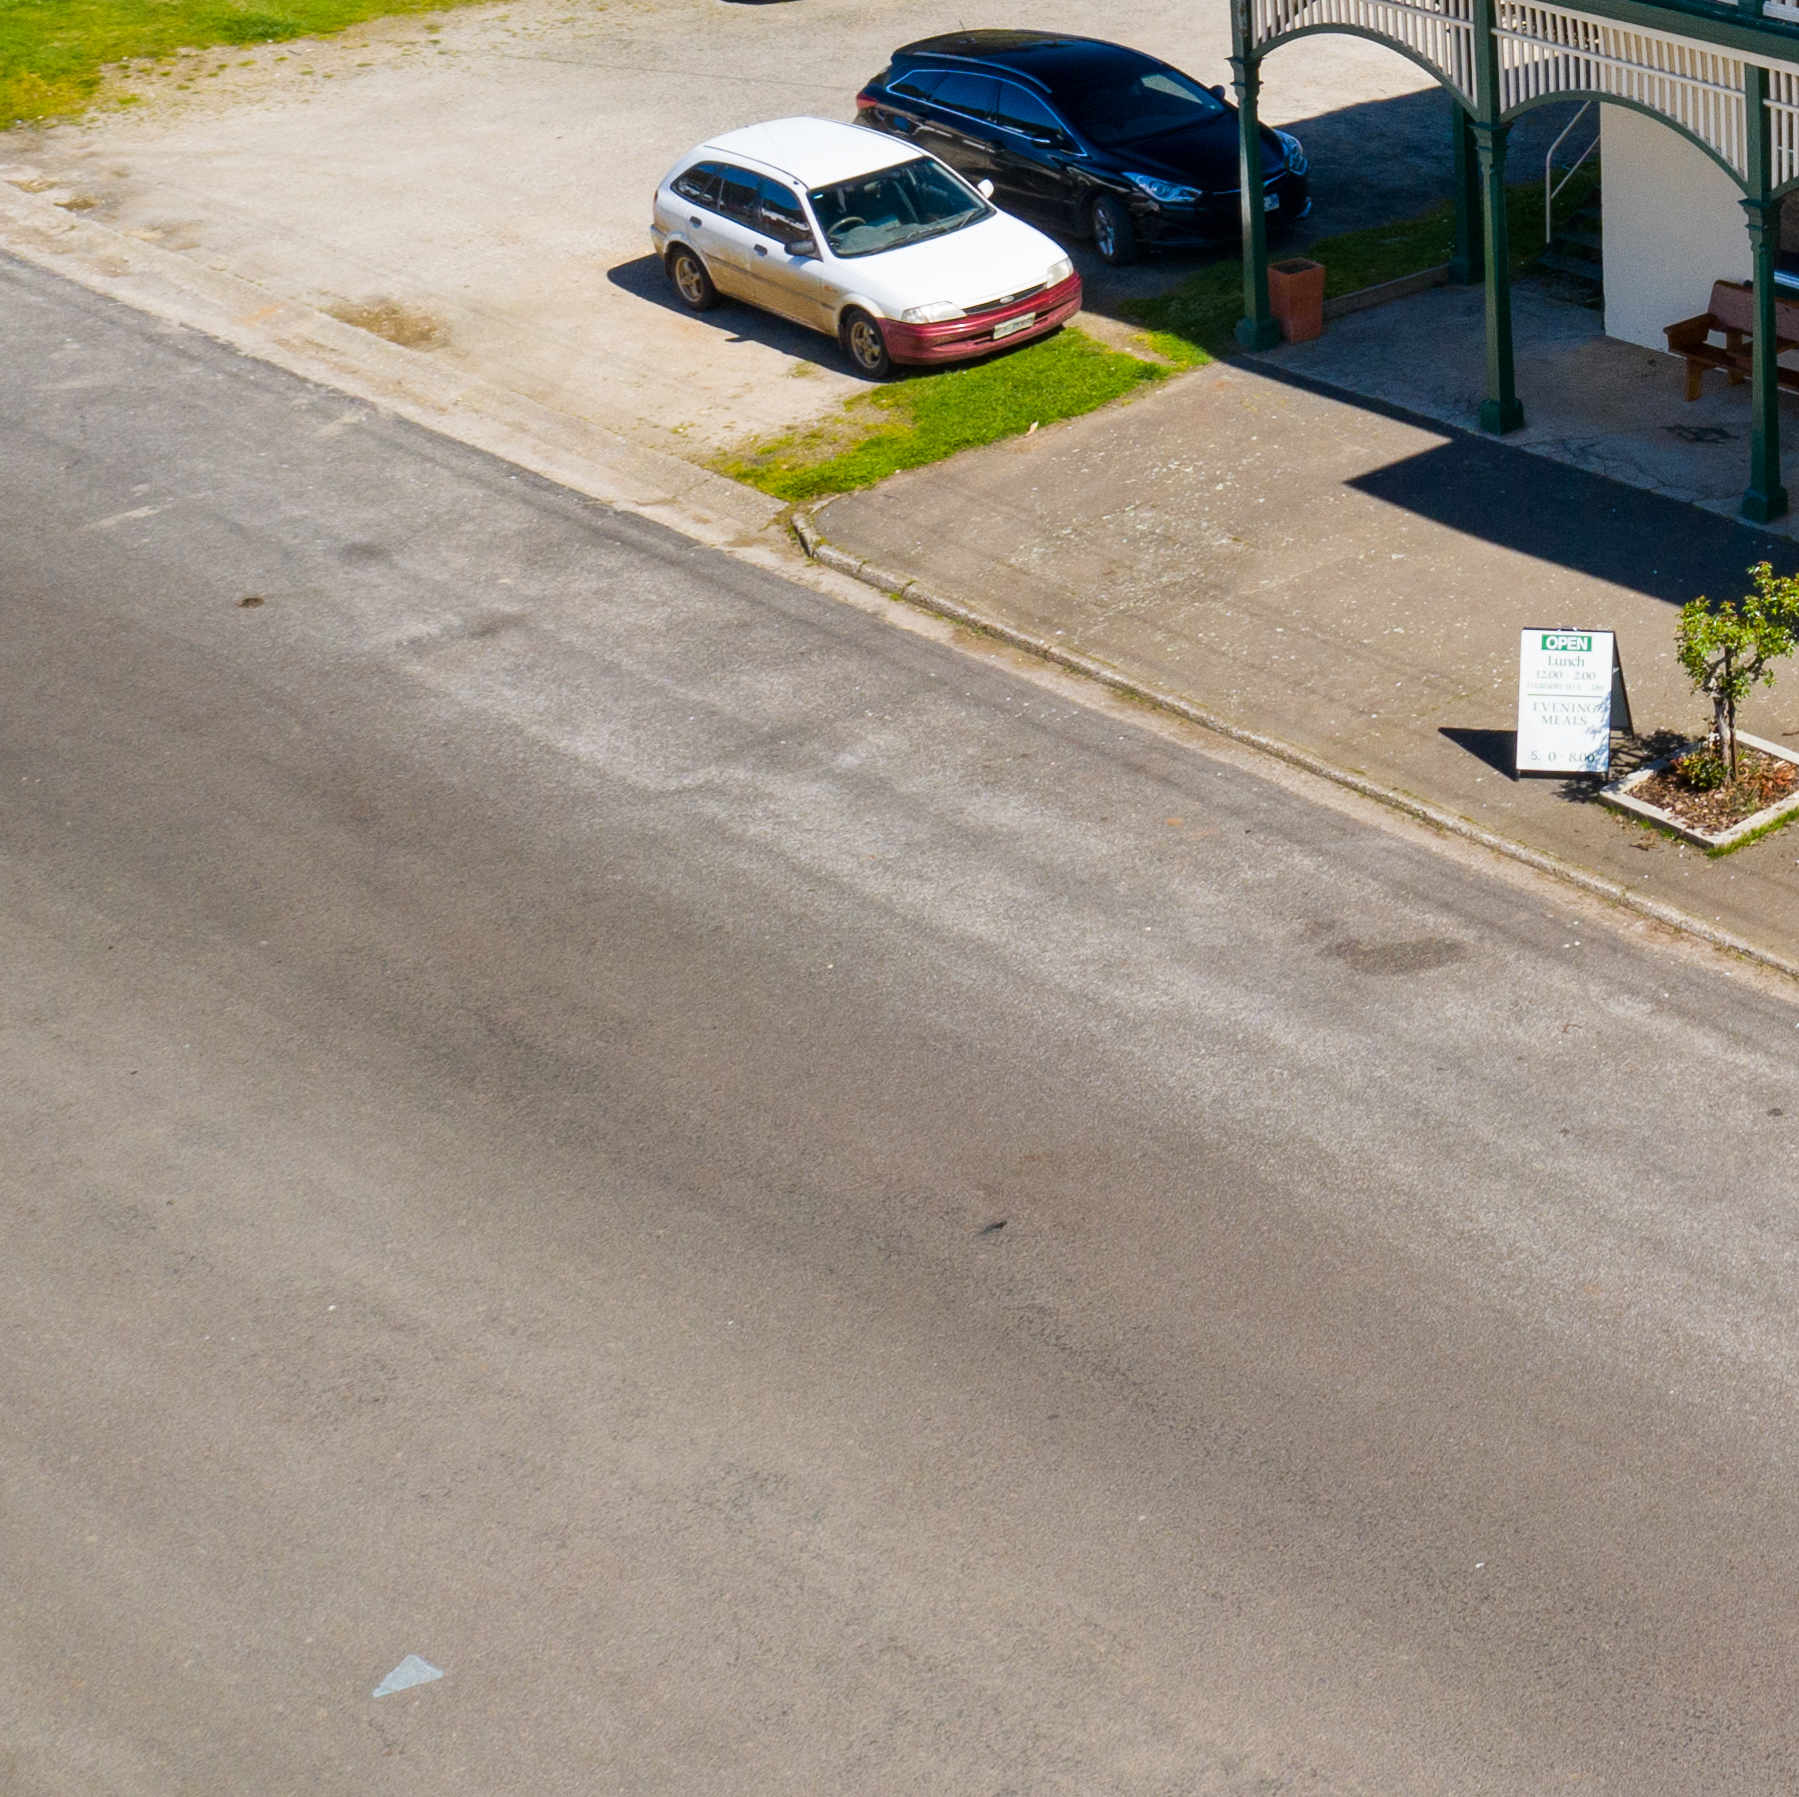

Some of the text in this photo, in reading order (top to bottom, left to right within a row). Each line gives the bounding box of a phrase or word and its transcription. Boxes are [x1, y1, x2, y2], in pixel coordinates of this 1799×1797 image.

[1546, 636, 1588, 650] OPEN
[1548, 655, 1584, 667] Lunch
[1536, 670, 1562, 679] 12.00
[1574, 671, 1596, 680] 2.00
[1533, 702, 1597, 713] EVENING
[1541, 715, 1588, 726] MEALS
[1569, 752, 1596, 763] 8.00
